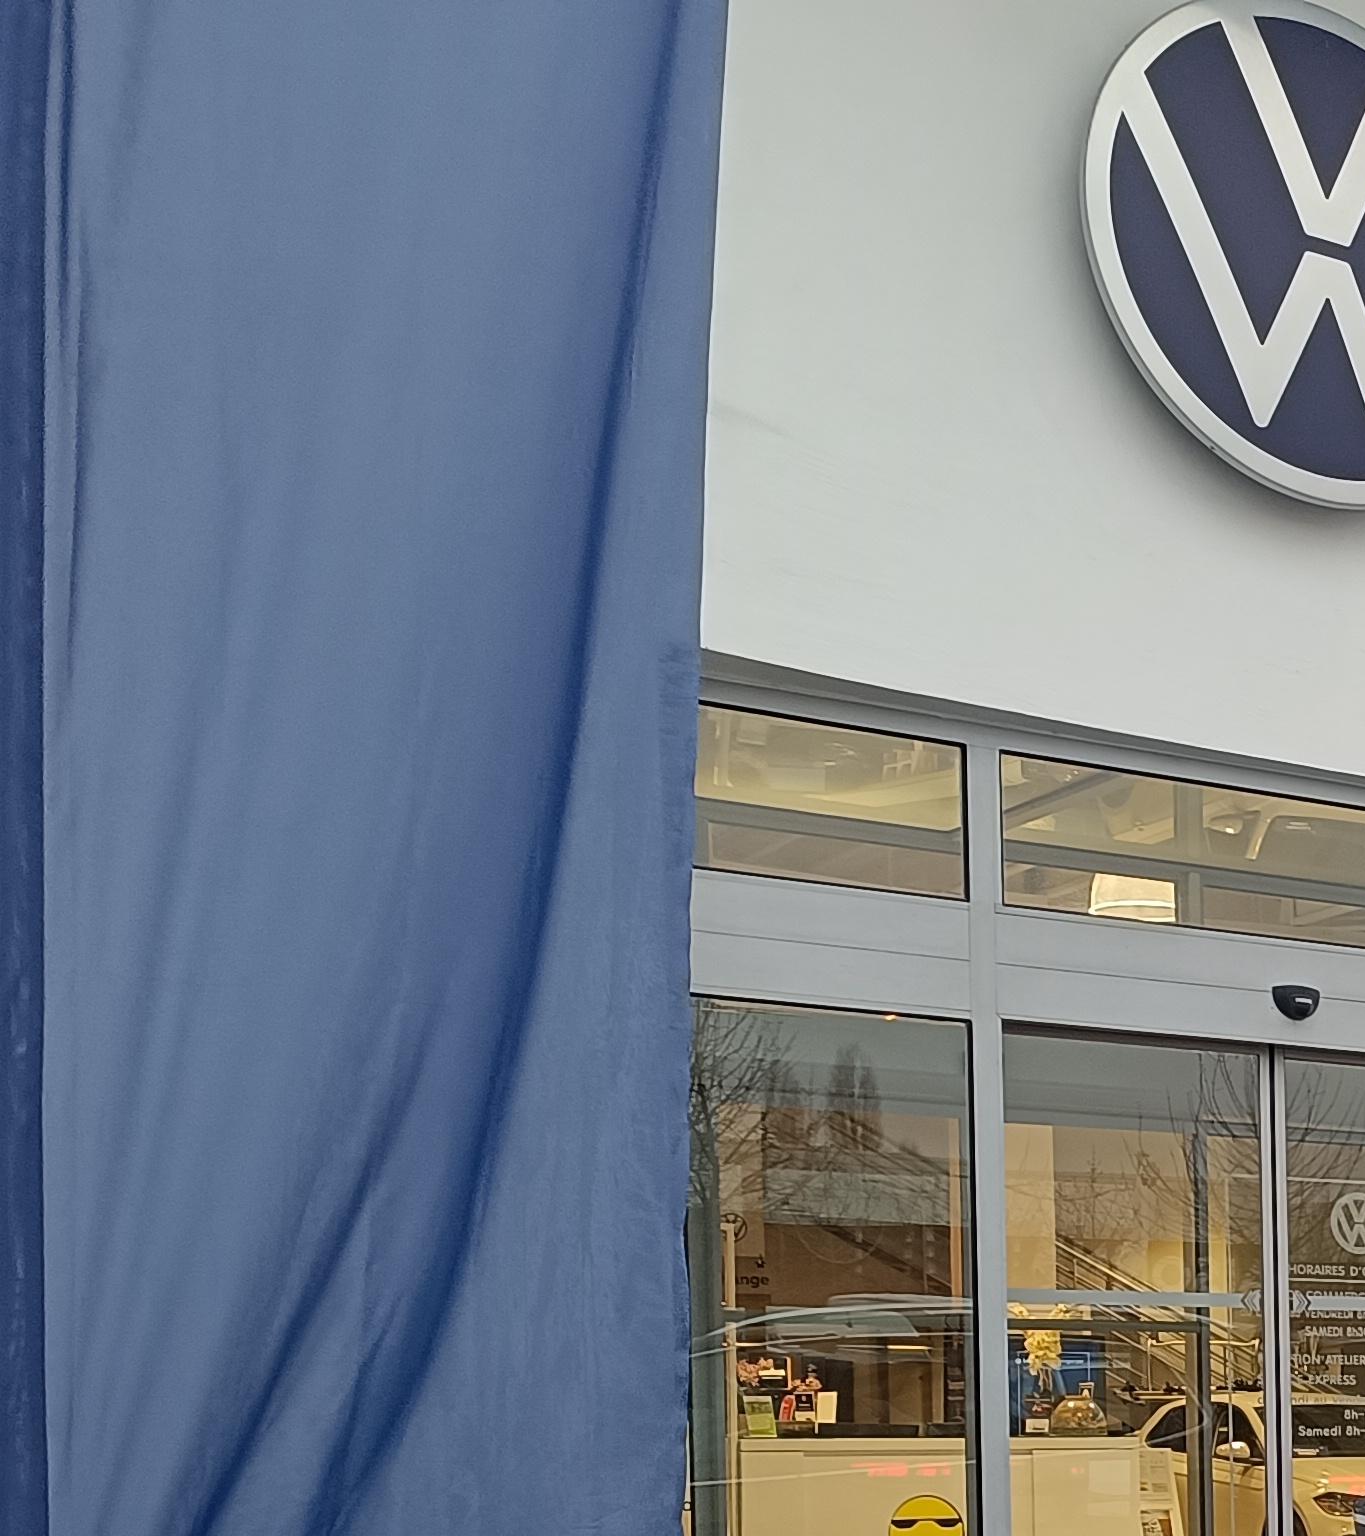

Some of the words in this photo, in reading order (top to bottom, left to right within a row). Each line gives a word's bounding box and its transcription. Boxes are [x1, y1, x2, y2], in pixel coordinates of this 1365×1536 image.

[1289, 1263, 1345, 1277] HORAIRES
[1304, 1326, 1343, 1337] SAMEDI
[1298, 1426, 1341, 1437] Samedi
